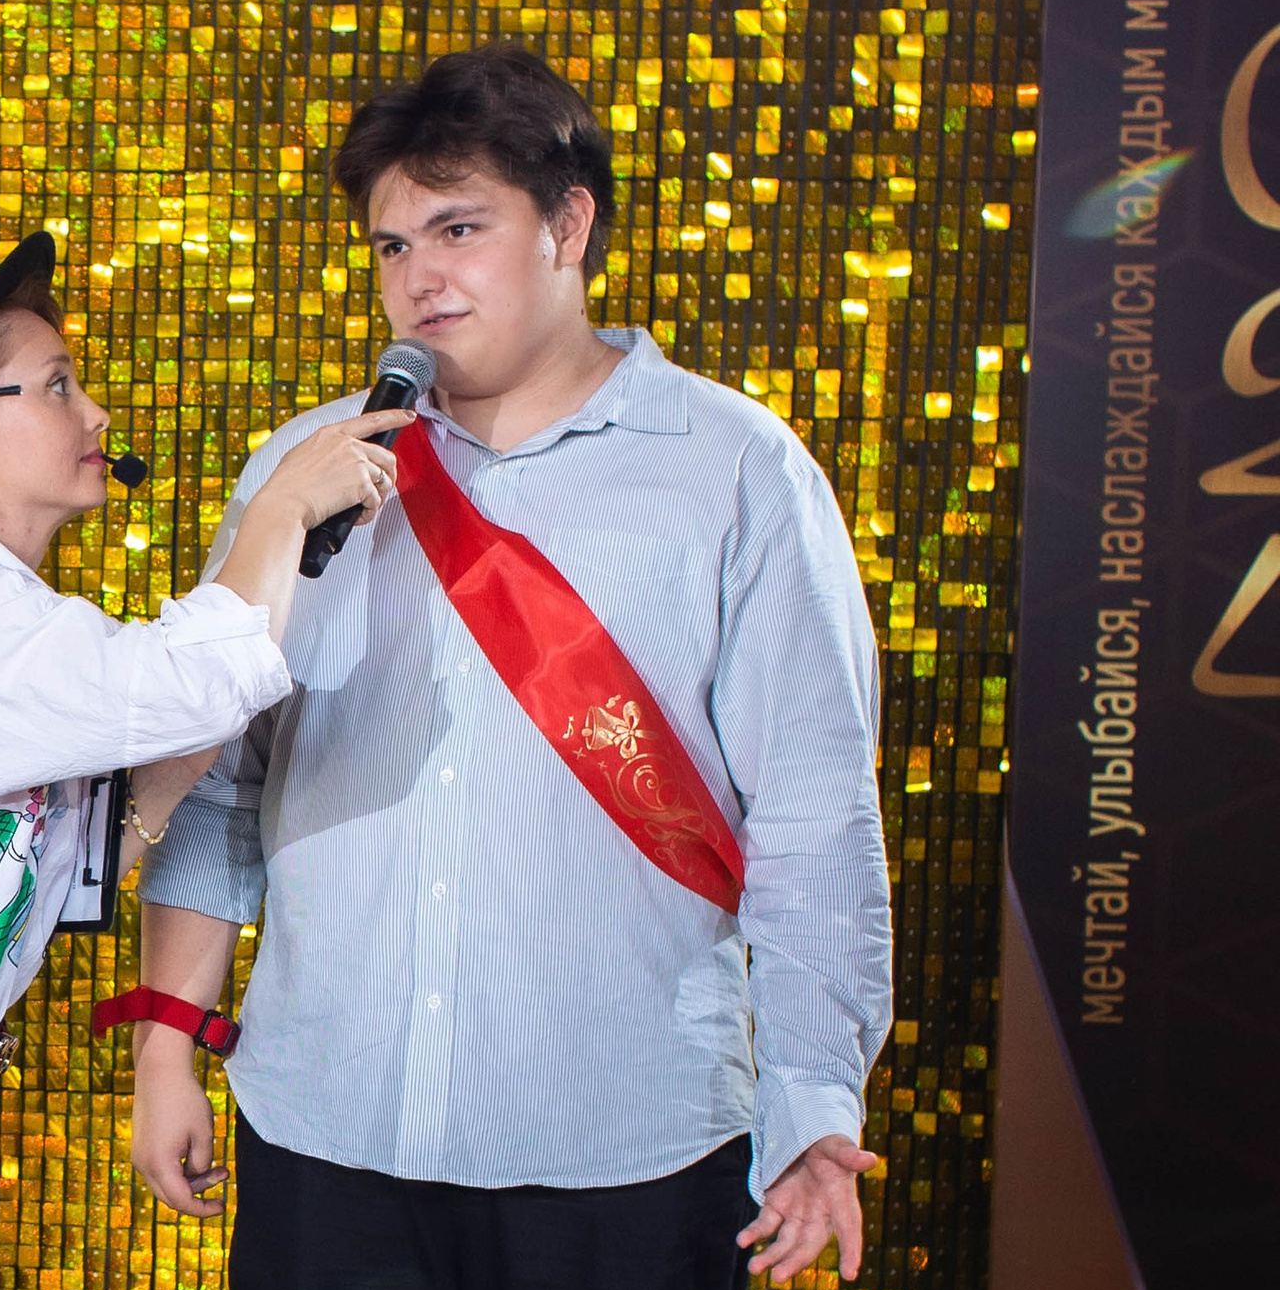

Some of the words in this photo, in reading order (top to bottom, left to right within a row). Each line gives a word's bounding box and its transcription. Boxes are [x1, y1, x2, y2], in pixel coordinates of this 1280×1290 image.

[1116, 46, 1173, 246] каждым
[1093, 263, 1161, 582] наслаждайся
[1078, 597, 1152, 837] улыбайся,
[1071, 849, 1141, 1025] мечтай,
